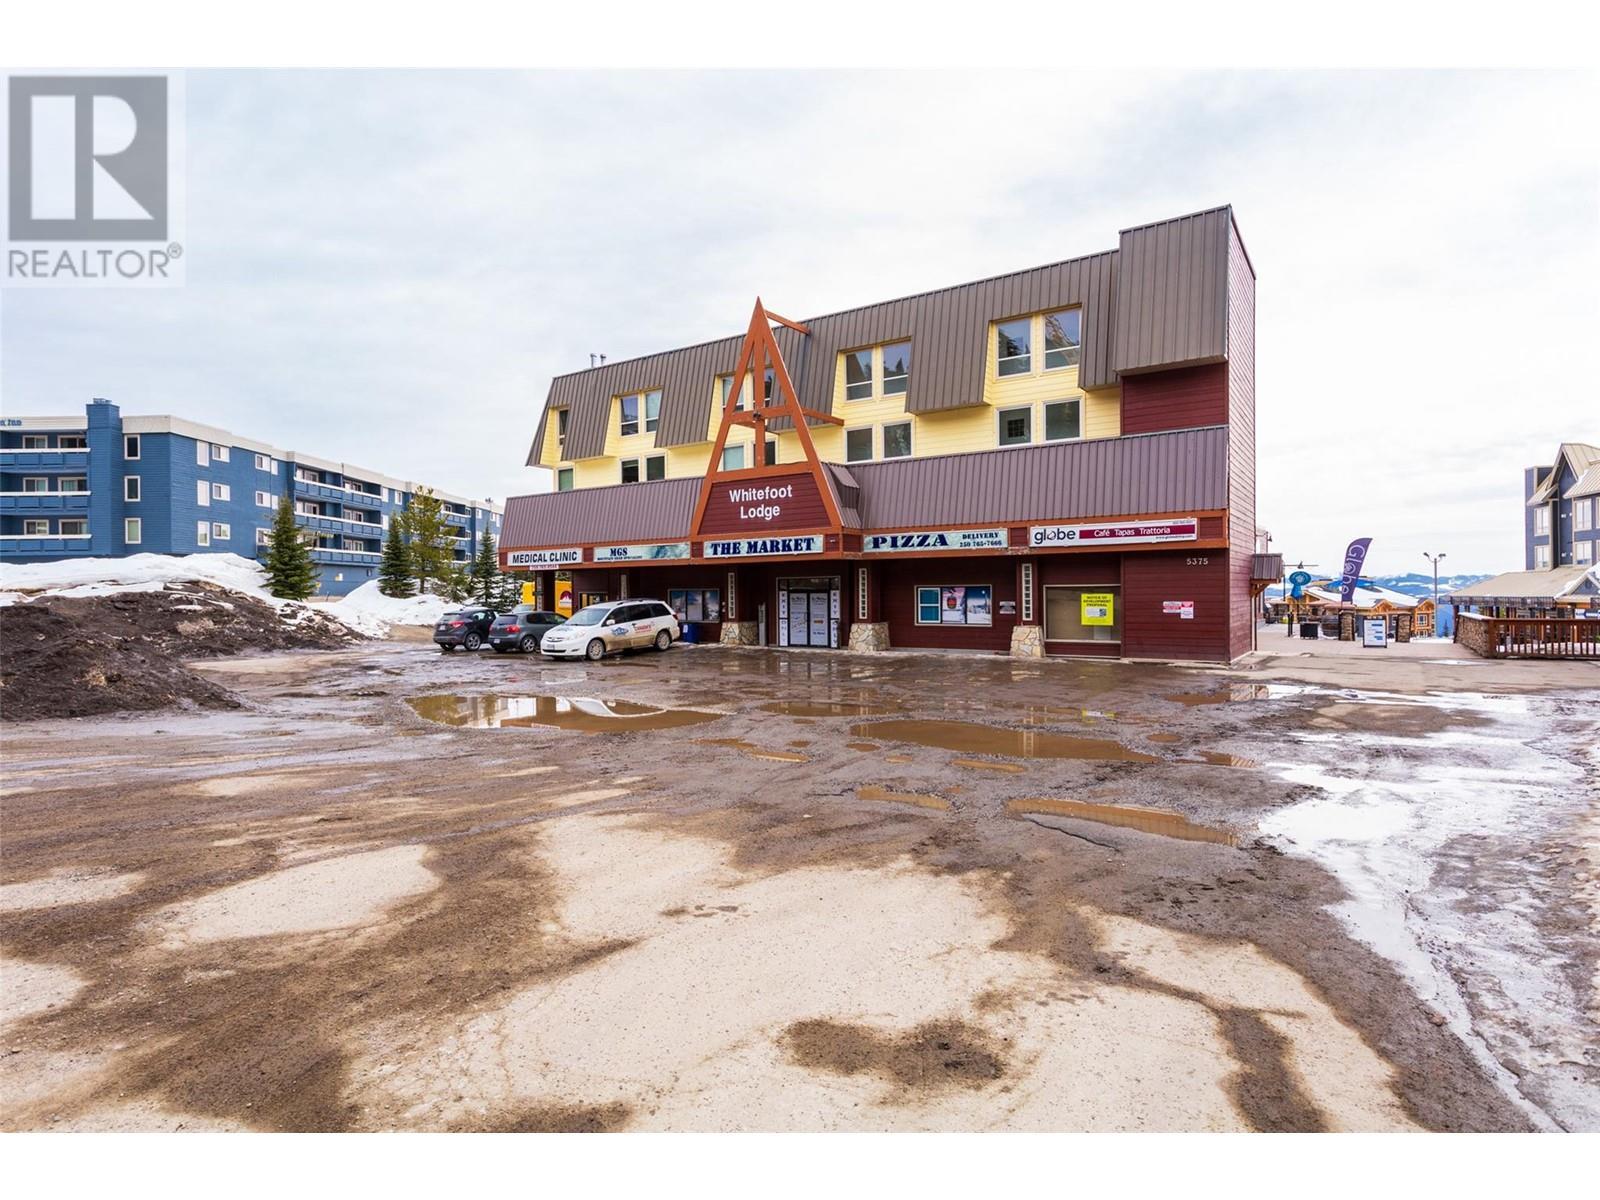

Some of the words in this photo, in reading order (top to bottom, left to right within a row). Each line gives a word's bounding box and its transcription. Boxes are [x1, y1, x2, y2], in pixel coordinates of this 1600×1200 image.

[729, 484, 793, 502] Whitefoot
[740, 504, 780, 520] Lodge
[962, 532, 1000, 540] DELIVERY
[1034, 527, 1076, 544] globe
[1094, 528, 1110, 537] Café
[1114, 528, 1135, 538] Tapas
[1139, 526, 1171, 535] Trattoria
[711, 541, 742, 556] THE
[746, 537, 815, 554] MARKET
[872, 532, 949, 549] PIZZA
[512, 552, 548, 564] MEDICAL
[549, 551, 578, 562] CLINIC
[609, 547, 628, 557] MGS
[1186, 557, 1209, 566] 5375
